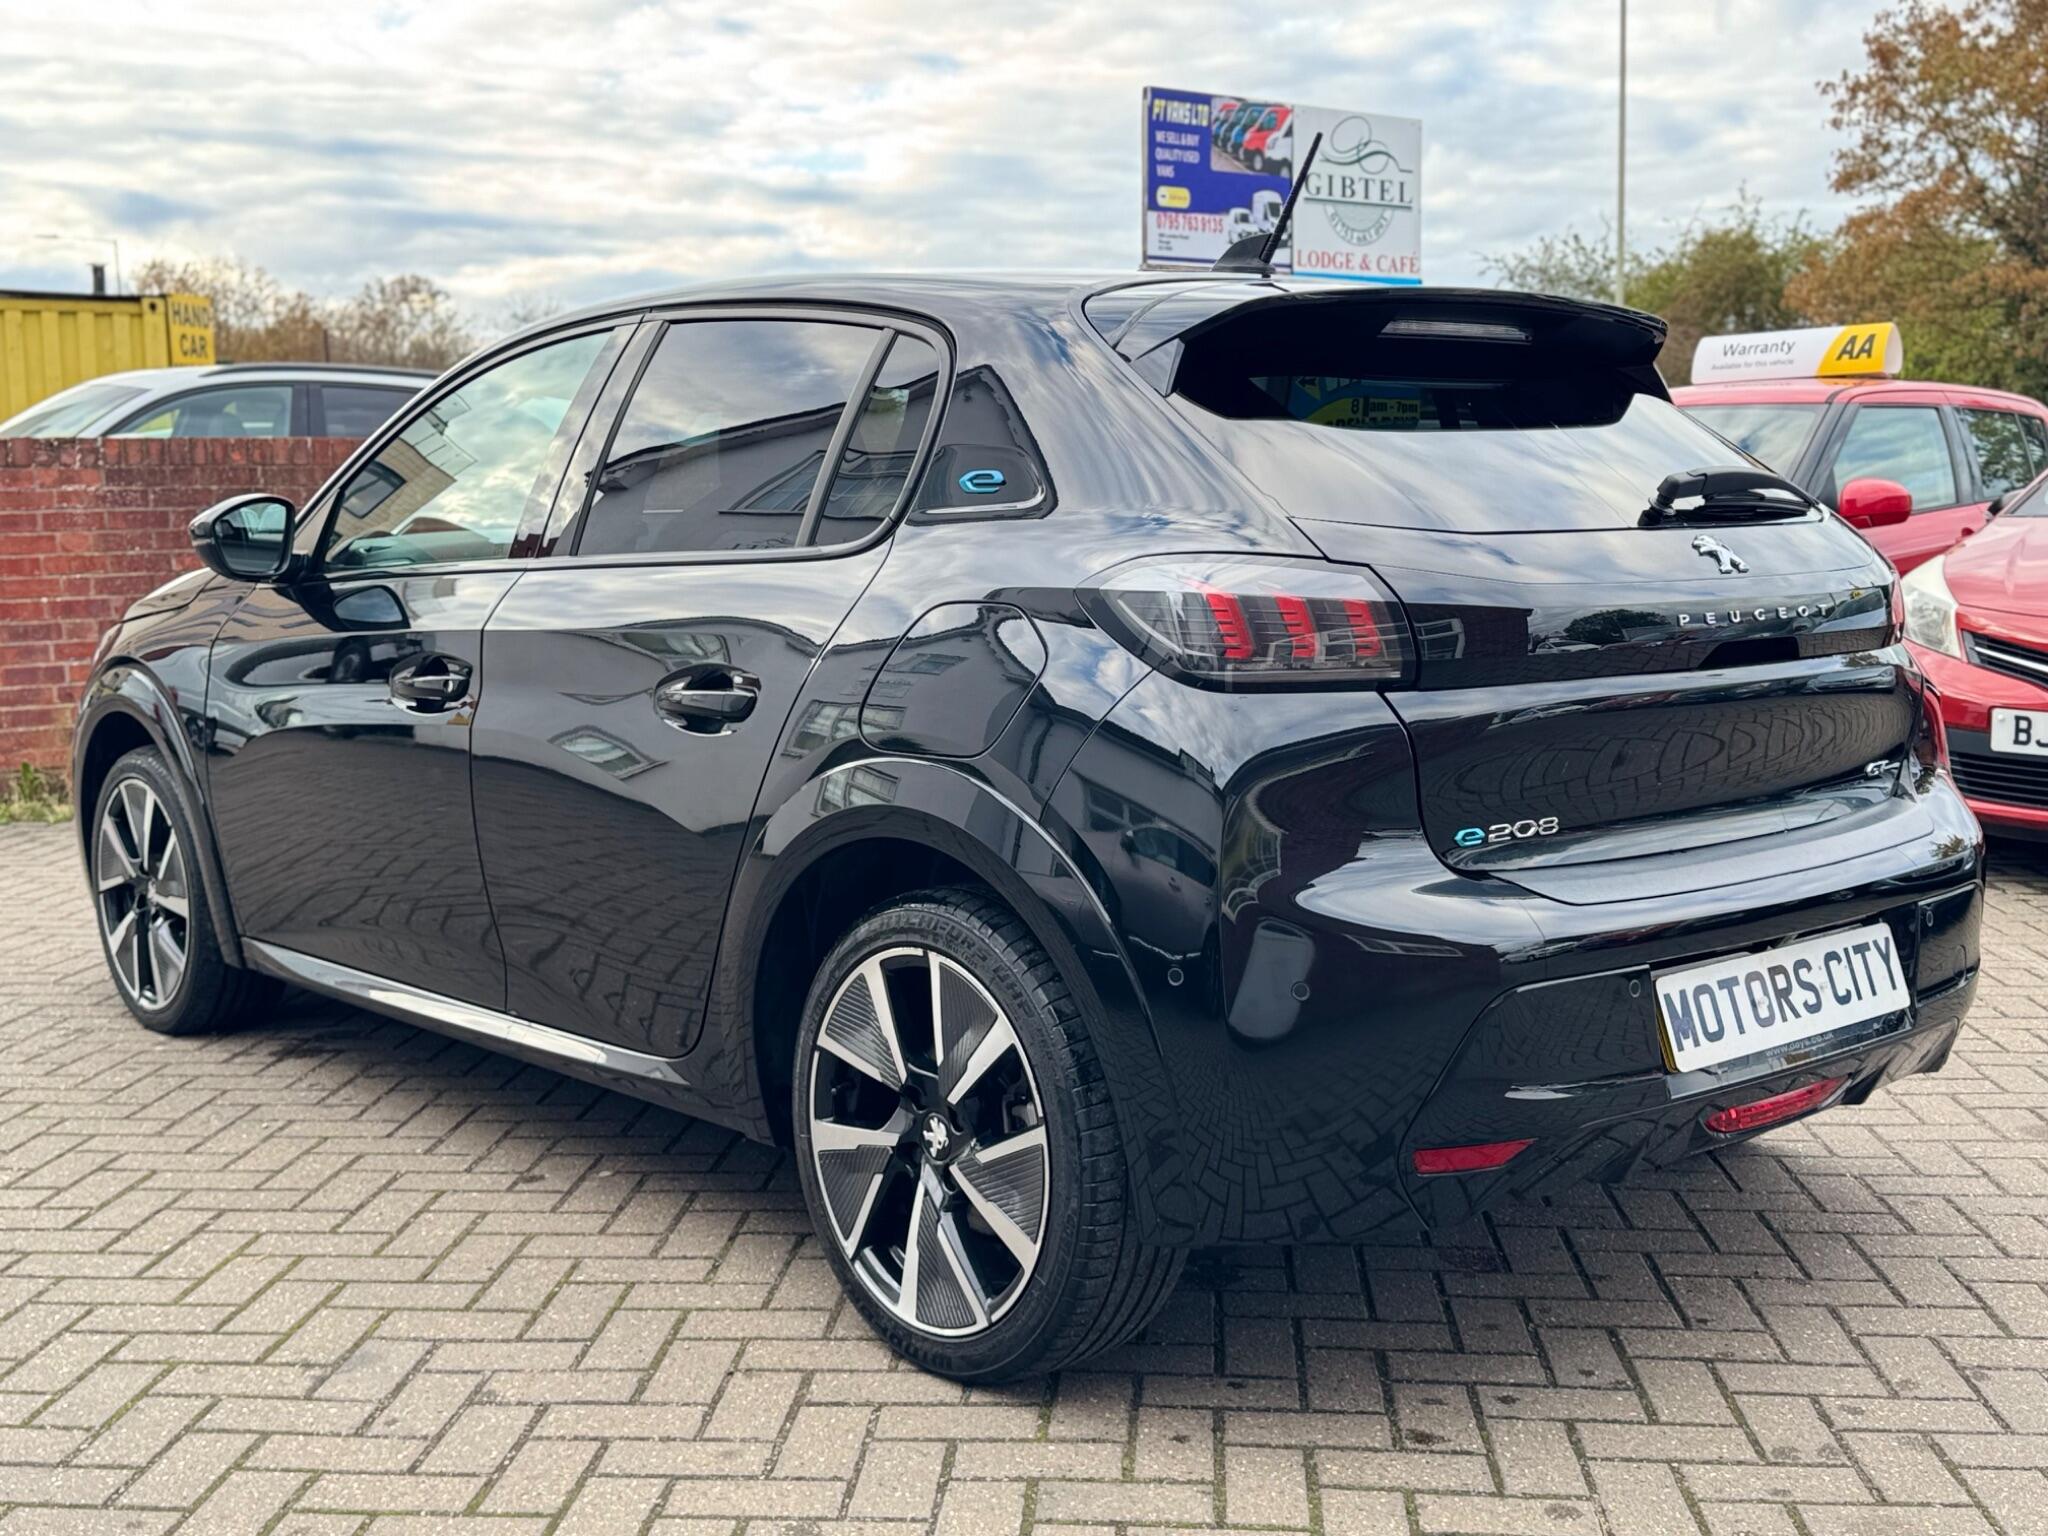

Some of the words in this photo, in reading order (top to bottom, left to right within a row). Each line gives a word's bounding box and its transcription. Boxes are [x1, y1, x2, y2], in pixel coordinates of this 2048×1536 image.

[1166, 100, 1191, 125] VANS
[1191, 103, 1209, 127] LTD
[1155, 146, 1182, 162] QUALITY
[1182, 150, 1200, 164] USED
[1156, 164, 1175, 178] VANS
[1304, 172, 1413, 204] GIBTEL
[1296, 249, 1355, 270] LODGE
[1359, 253, 1371, 271] &
[1376, 251, 1420, 274] CAFÉ
[172, 301, 209, 328] HAND
[180, 332, 209, 359] CAR
[1722, 340, 1796, 357] Warranty
[1835, 333, 1877, 361] AA
[1677, 603, 1829, 627] PEUGEOT
[1663, 957, 1823, 1053] MOTORS
[1823, 936, 1898, 1006] CITY
